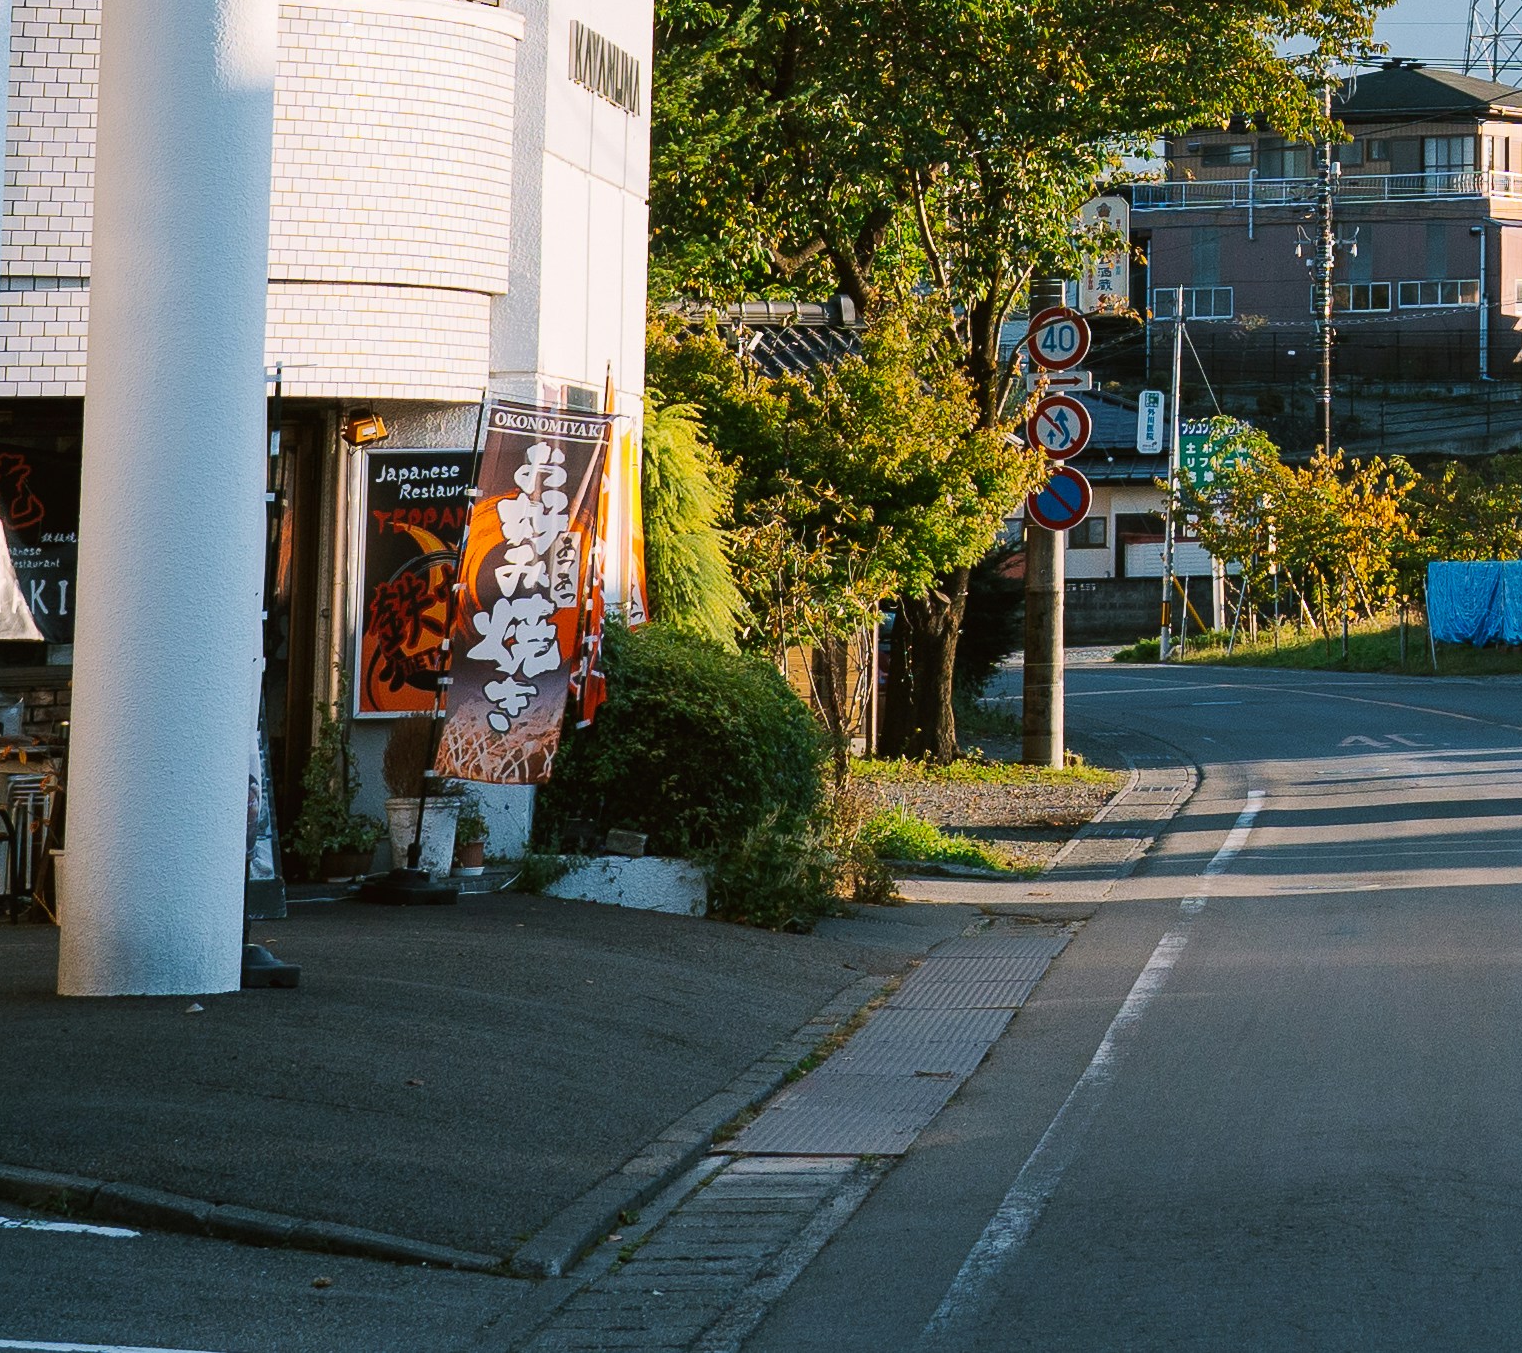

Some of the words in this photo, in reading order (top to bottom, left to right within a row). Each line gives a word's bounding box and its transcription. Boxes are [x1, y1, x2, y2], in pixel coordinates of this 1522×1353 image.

[1041, 325, 1075, 352] 40
[494, 411, 606, 439] OKONOMIYAKI
[375, 464, 460, 484] Japanese
[399, 483, 477, 500] Restaur
[12, 558, 60, 568] estaurant
[466, 441, 570, 733] お好み焼き
